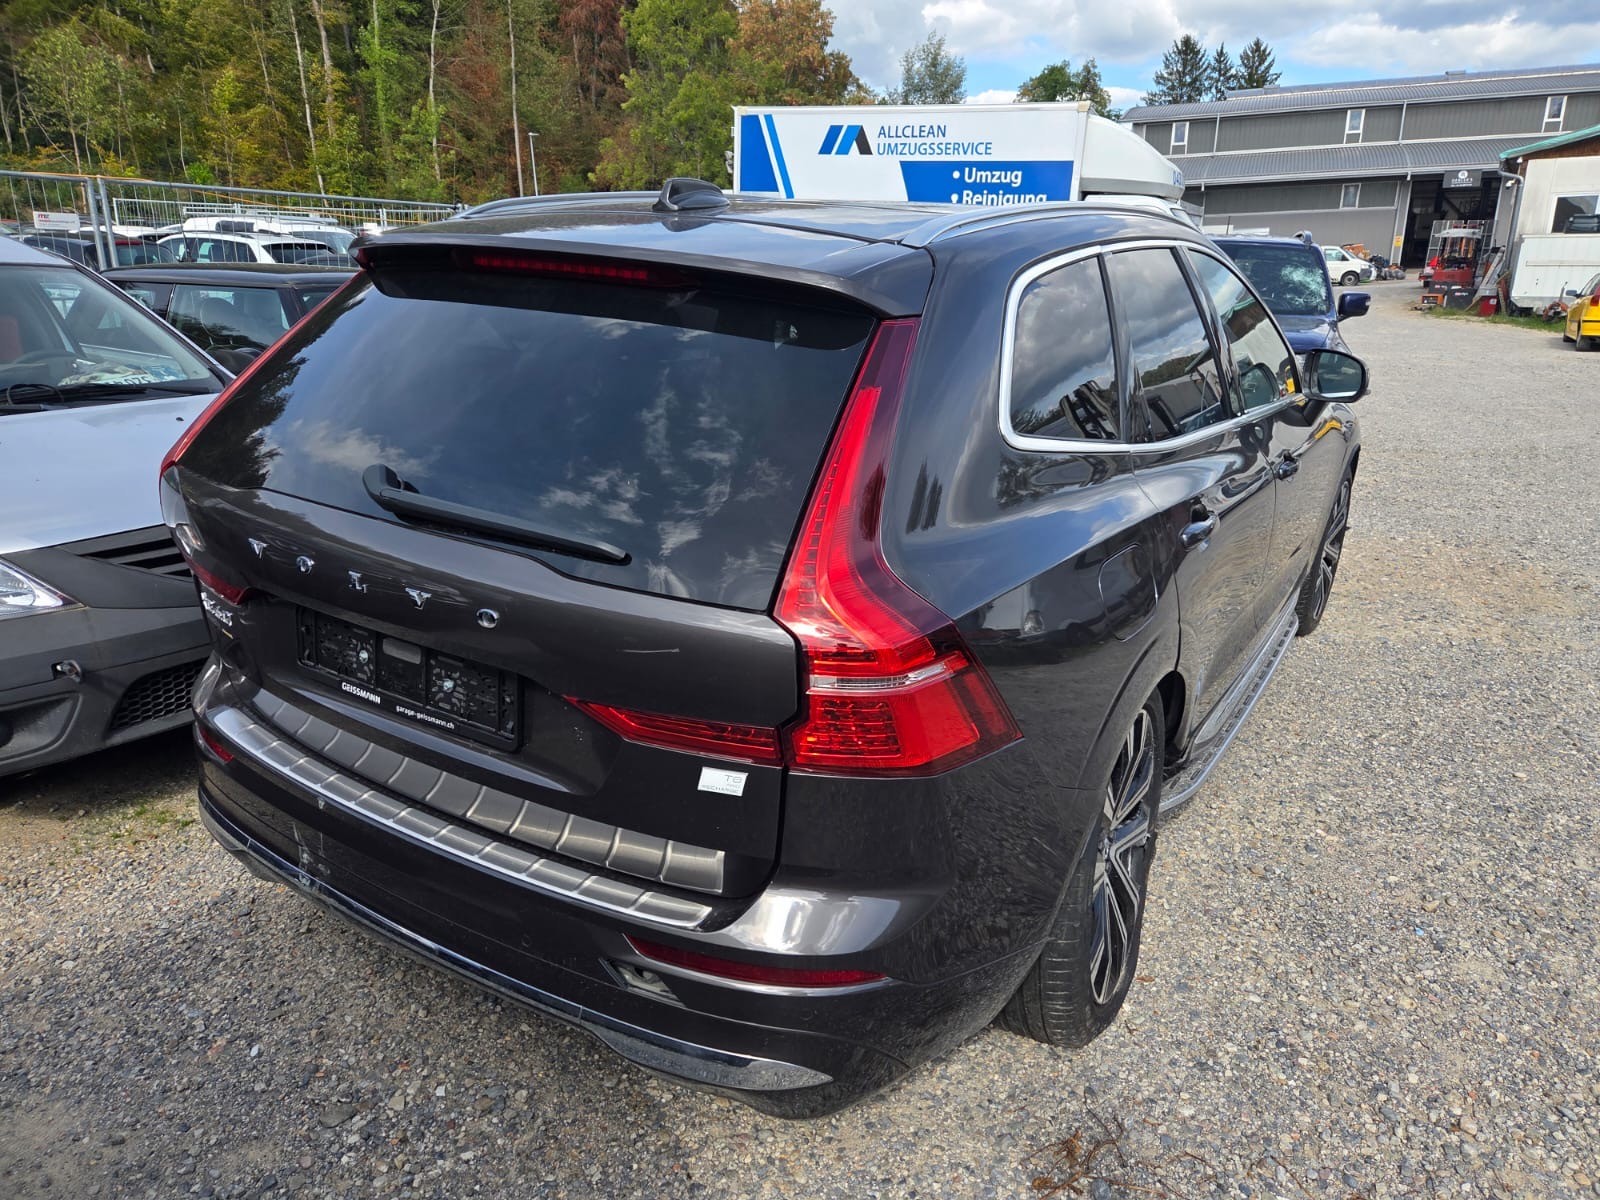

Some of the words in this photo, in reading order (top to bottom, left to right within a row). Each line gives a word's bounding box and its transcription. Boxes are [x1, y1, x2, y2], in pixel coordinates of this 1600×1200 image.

[877, 124, 947, 139] ALLCLEAN
[876, 142, 993, 156] UMZUGSSERVICE
[964, 166, 1023, 187] Umzug
[962, 190, 1048, 205] Reinigung
[248, 537, 500, 629] VOLVO
[341, 682, 381, 704] GEISSMANN
[395, 705, 455, 730] garage-geissmann.ch
